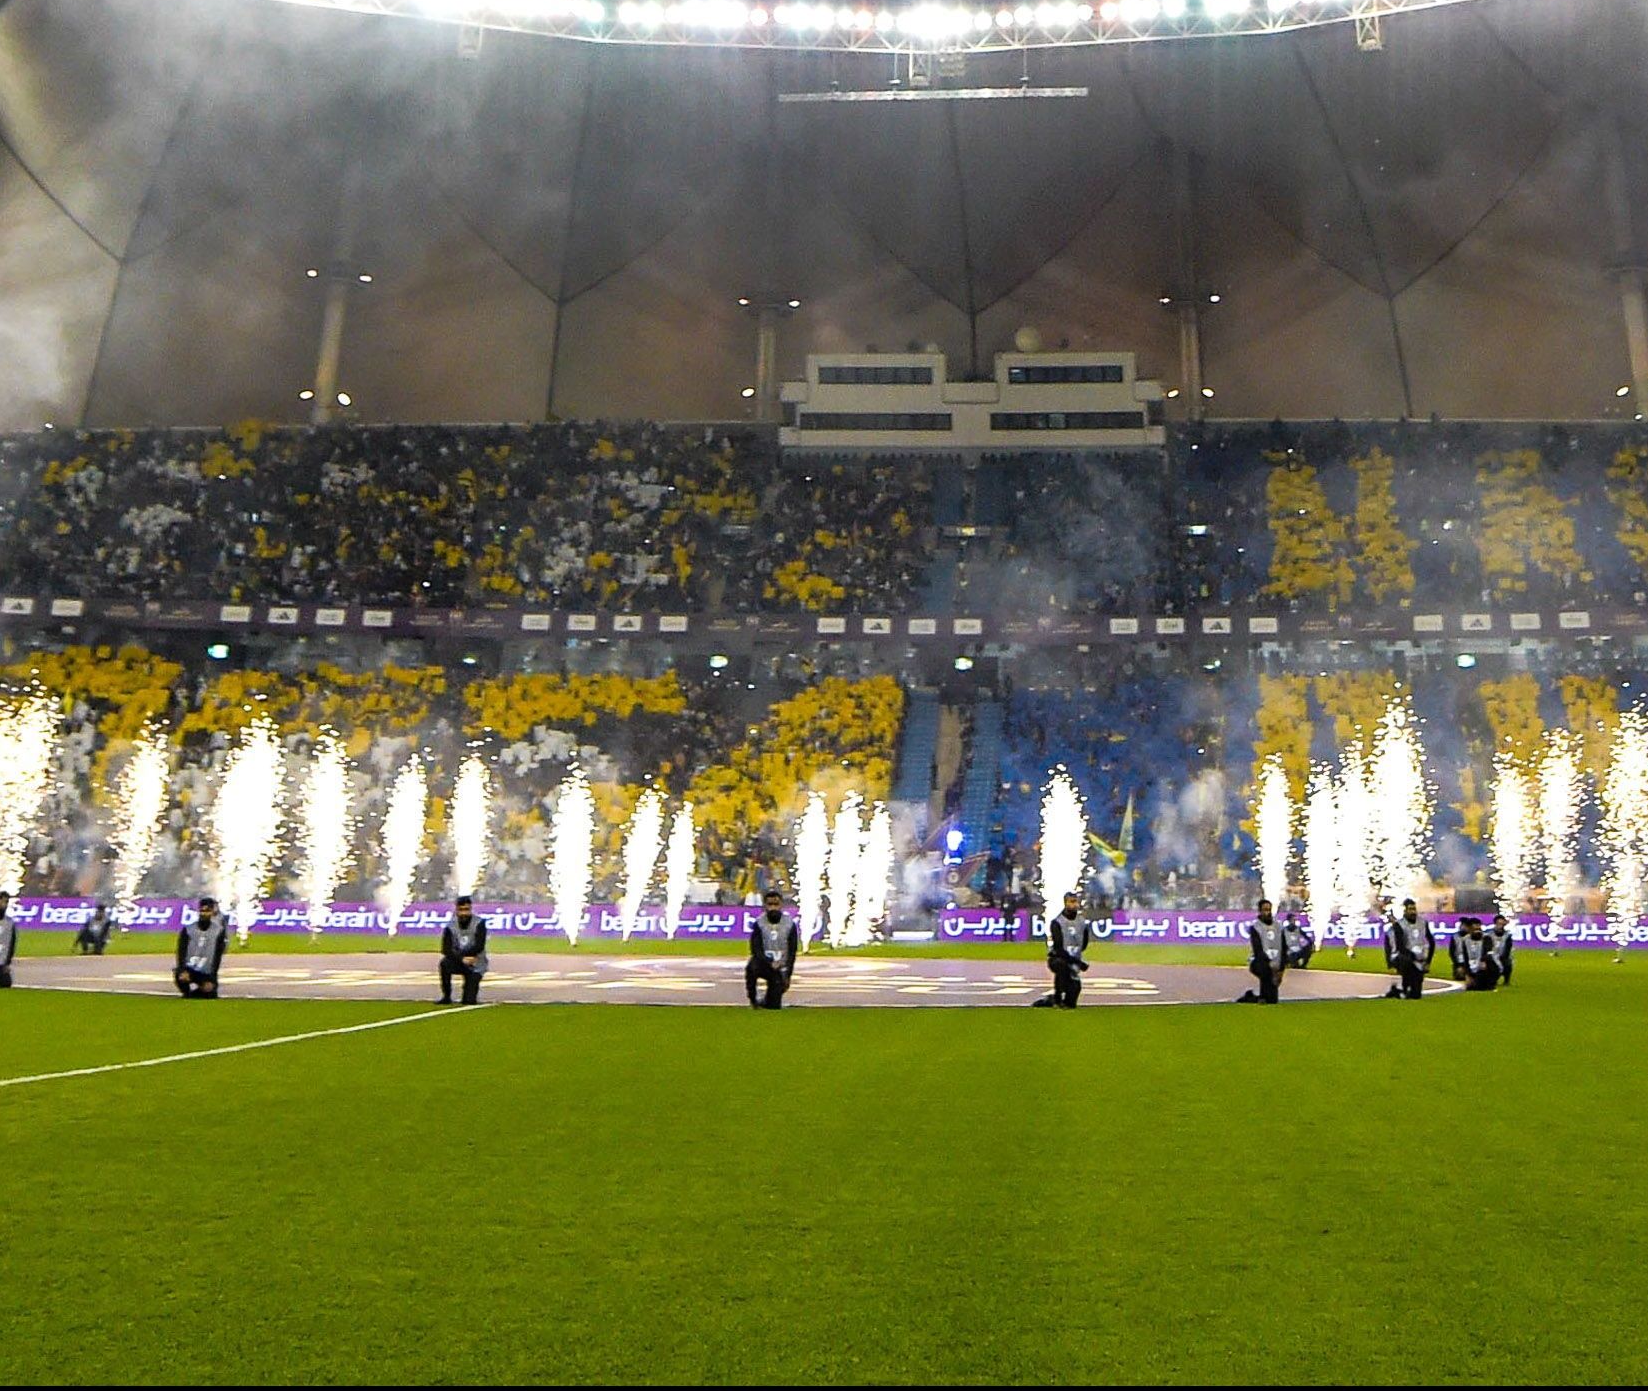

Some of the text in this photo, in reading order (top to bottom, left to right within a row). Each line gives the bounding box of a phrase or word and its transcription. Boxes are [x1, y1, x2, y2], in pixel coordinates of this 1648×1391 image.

[943, 915, 1022, 936] بيرين
[1091, 915, 1170, 937] بيرين
[1178, 913, 1236, 939] berain
